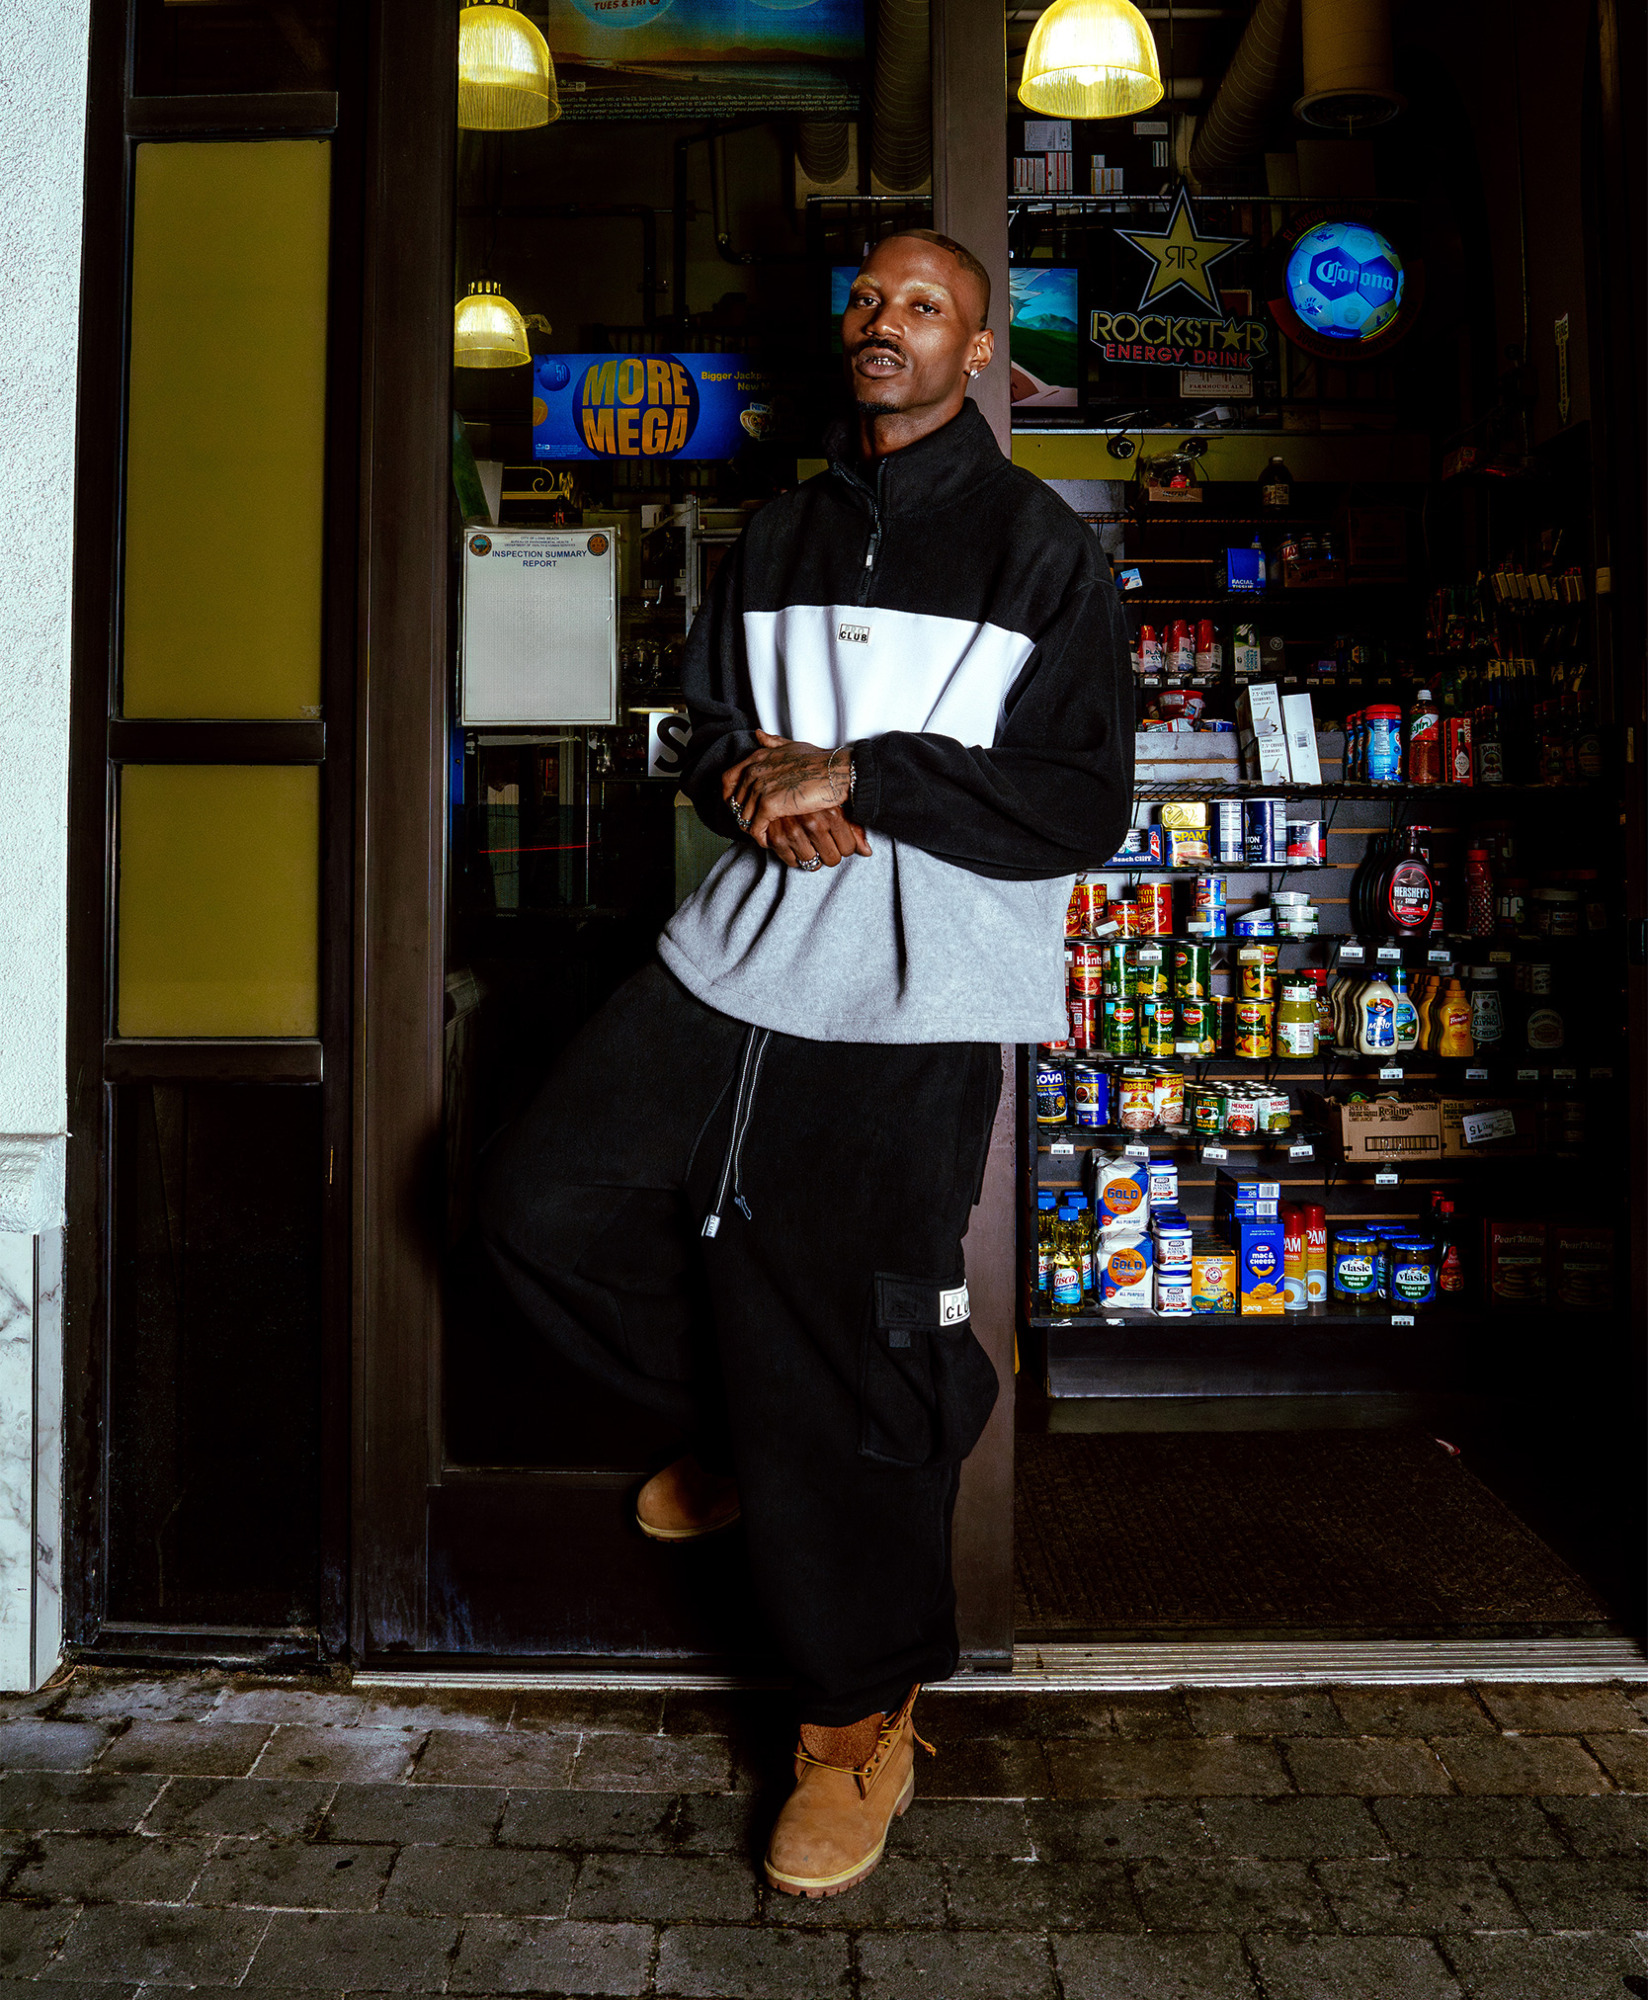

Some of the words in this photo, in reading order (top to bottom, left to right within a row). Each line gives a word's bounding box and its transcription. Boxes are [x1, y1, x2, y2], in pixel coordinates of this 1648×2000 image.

[594, 0, 619, 10] TUES
[1316, 259, 1393, 291] Corona
[1106, 344, 1184, 362] ENERGY
[1193, 349, 1251, 367] DRINK
[582, 358, 691, 406] MORE
[701, 371, 732, 381] Bigger
[582, 407, 689, 456] MEGA
[492, 550, 543, 558] INSPECTION
[545, 550, 587, 558] SUMMARY
[845, 625, 864, 633] PRO
[840, 631, 867, 641] CLUB
[1463, 718, 1472, 743] CLASSIC
[1173, 831, 1206, 842] SPAM
[1394, 886, 1429, 898] HERSHEY'S
[1123, 1081, 1153, 1091] Rosarita
[1107, 1187, 1138, 1199] GOLD
[1306, 1230, 1325, 1245] PAM
[1112, 1256, 1142, 1270] GOLD
[1342, 1263, 1370, 1272] vlasic
[1054, 1274, 1075, 1288] Crisco
[1399, 1273, 1428, 1281] vlasic
[946, 1300, 969, 1320] CLU
